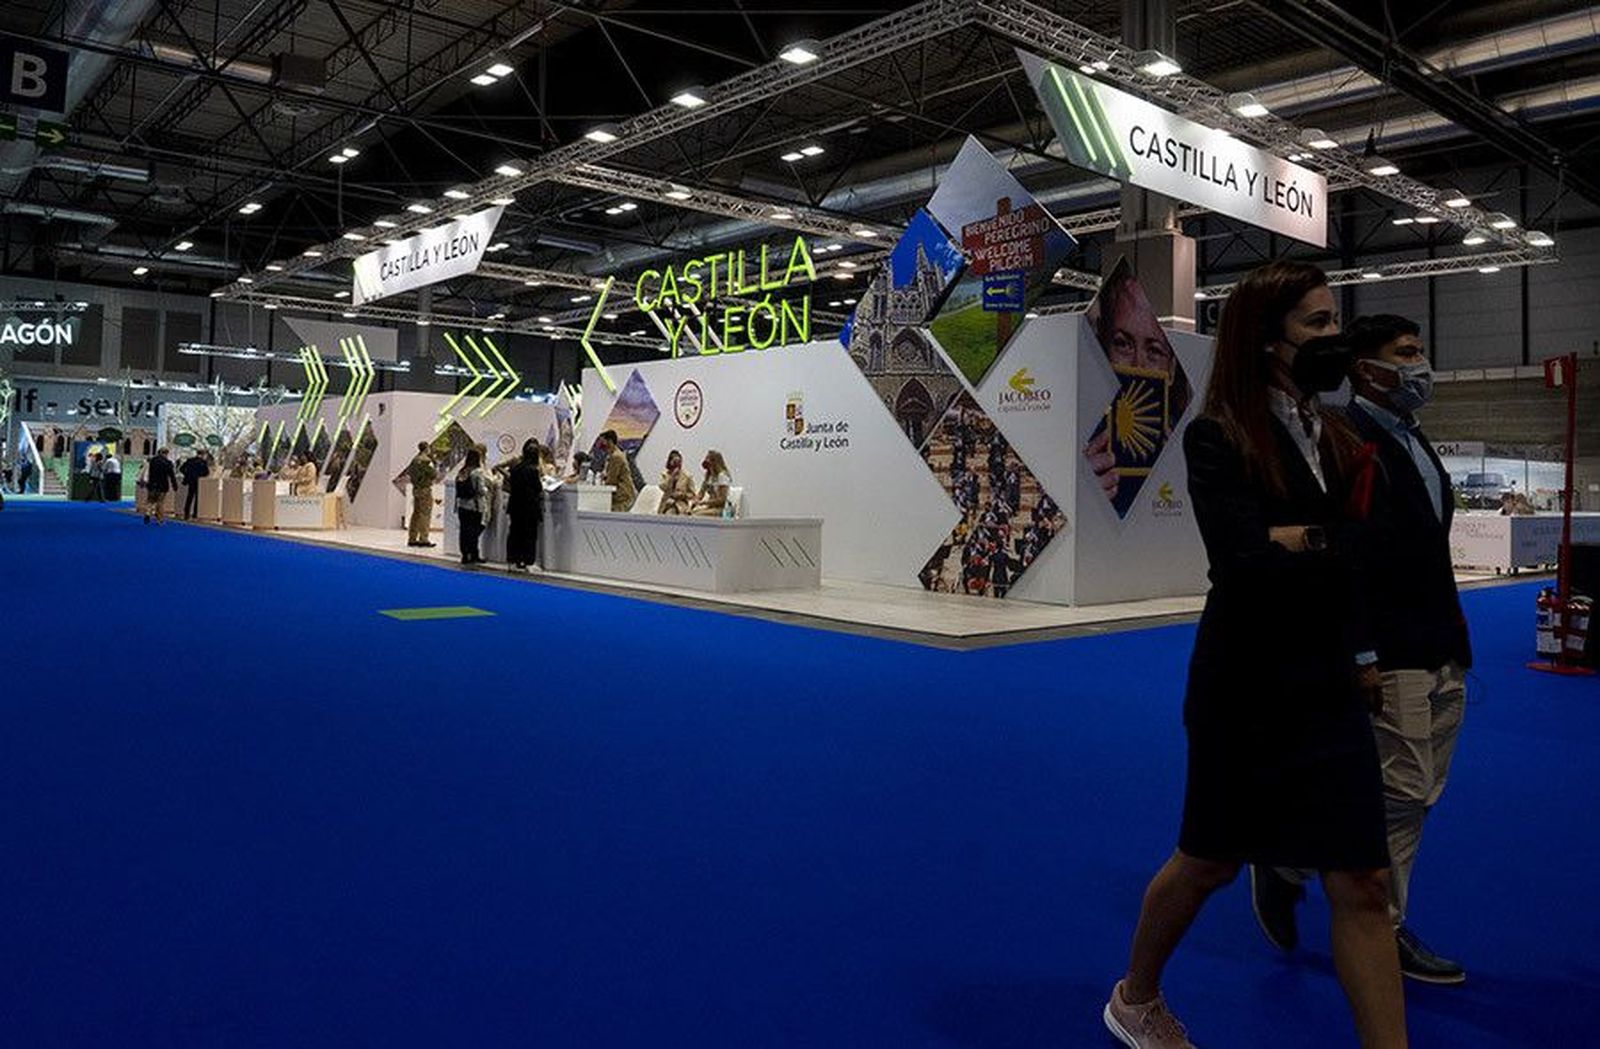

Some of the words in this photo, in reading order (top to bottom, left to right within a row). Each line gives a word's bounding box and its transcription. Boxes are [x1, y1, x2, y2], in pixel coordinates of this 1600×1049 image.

[11, 51, 48, 98] B
[1129, 125, 1239, 192] CASTILLA
[1245, 169, 1258, 197] Y
[1263, 176, 1313, 218] LEÓN
[379, 249, 430, 281] CASTILLA
[433, 243, 442, 264] Y
[443, 229, 480, 261] LEÓN
[975, 238, 1032, 260] WELCOME
[635, 235, 817, 313] CASTILLA
[0, 317, 73, 345] AGÓN
[663, 315, 688, 360] Y
[700, 292, 811, 356] LEÓN
[780, 437, 813, 450] Castilla
[815, 438, 822, 452] y
[824, 436, 849, 448] León
[806, 422, 834, 434] Junta
[836, 421, 849, 433] de
